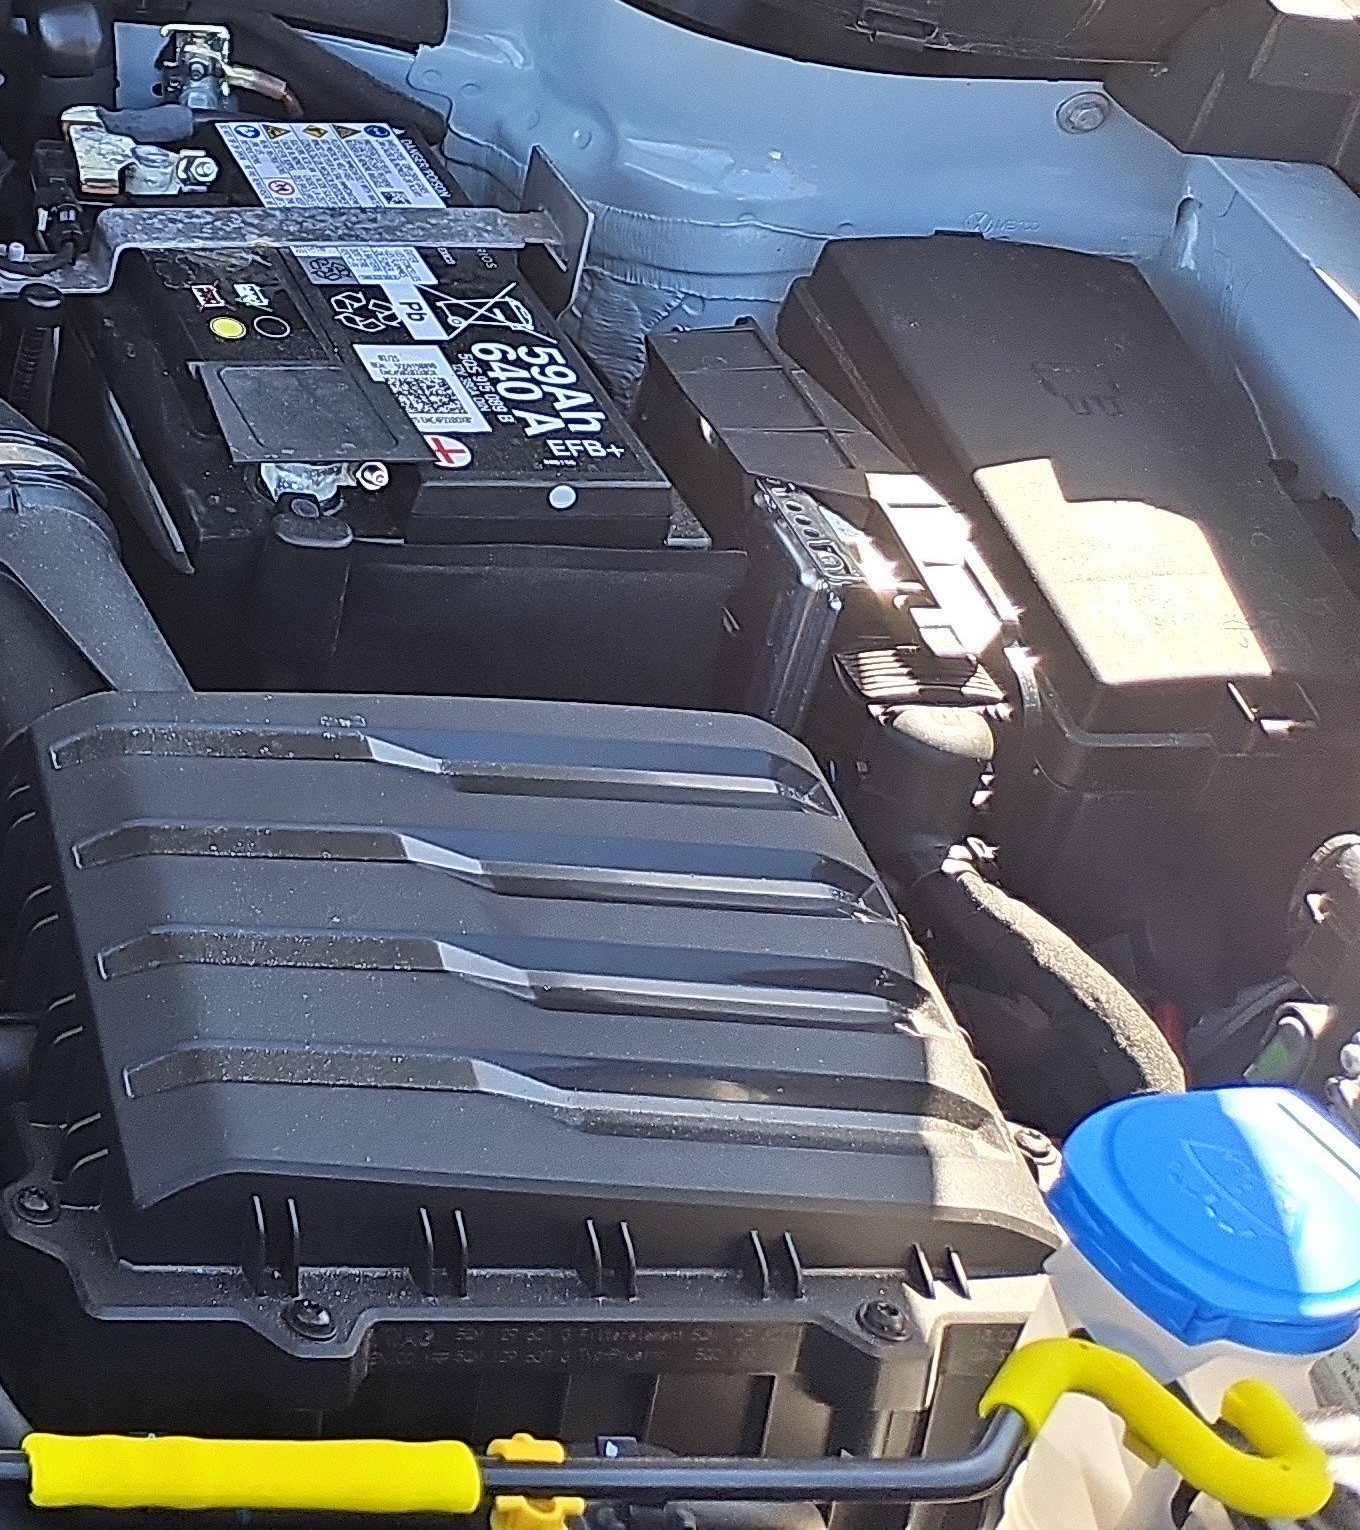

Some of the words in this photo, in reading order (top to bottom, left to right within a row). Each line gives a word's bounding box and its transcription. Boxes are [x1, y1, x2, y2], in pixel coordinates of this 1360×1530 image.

[399, 301, 427, 322] Pb
[471, 342, 543, 401] 640
[511, 410, 566, 437] A
[516, 345, 606, 432] 59Ah
[546, 438, 625, 459] EFB+
